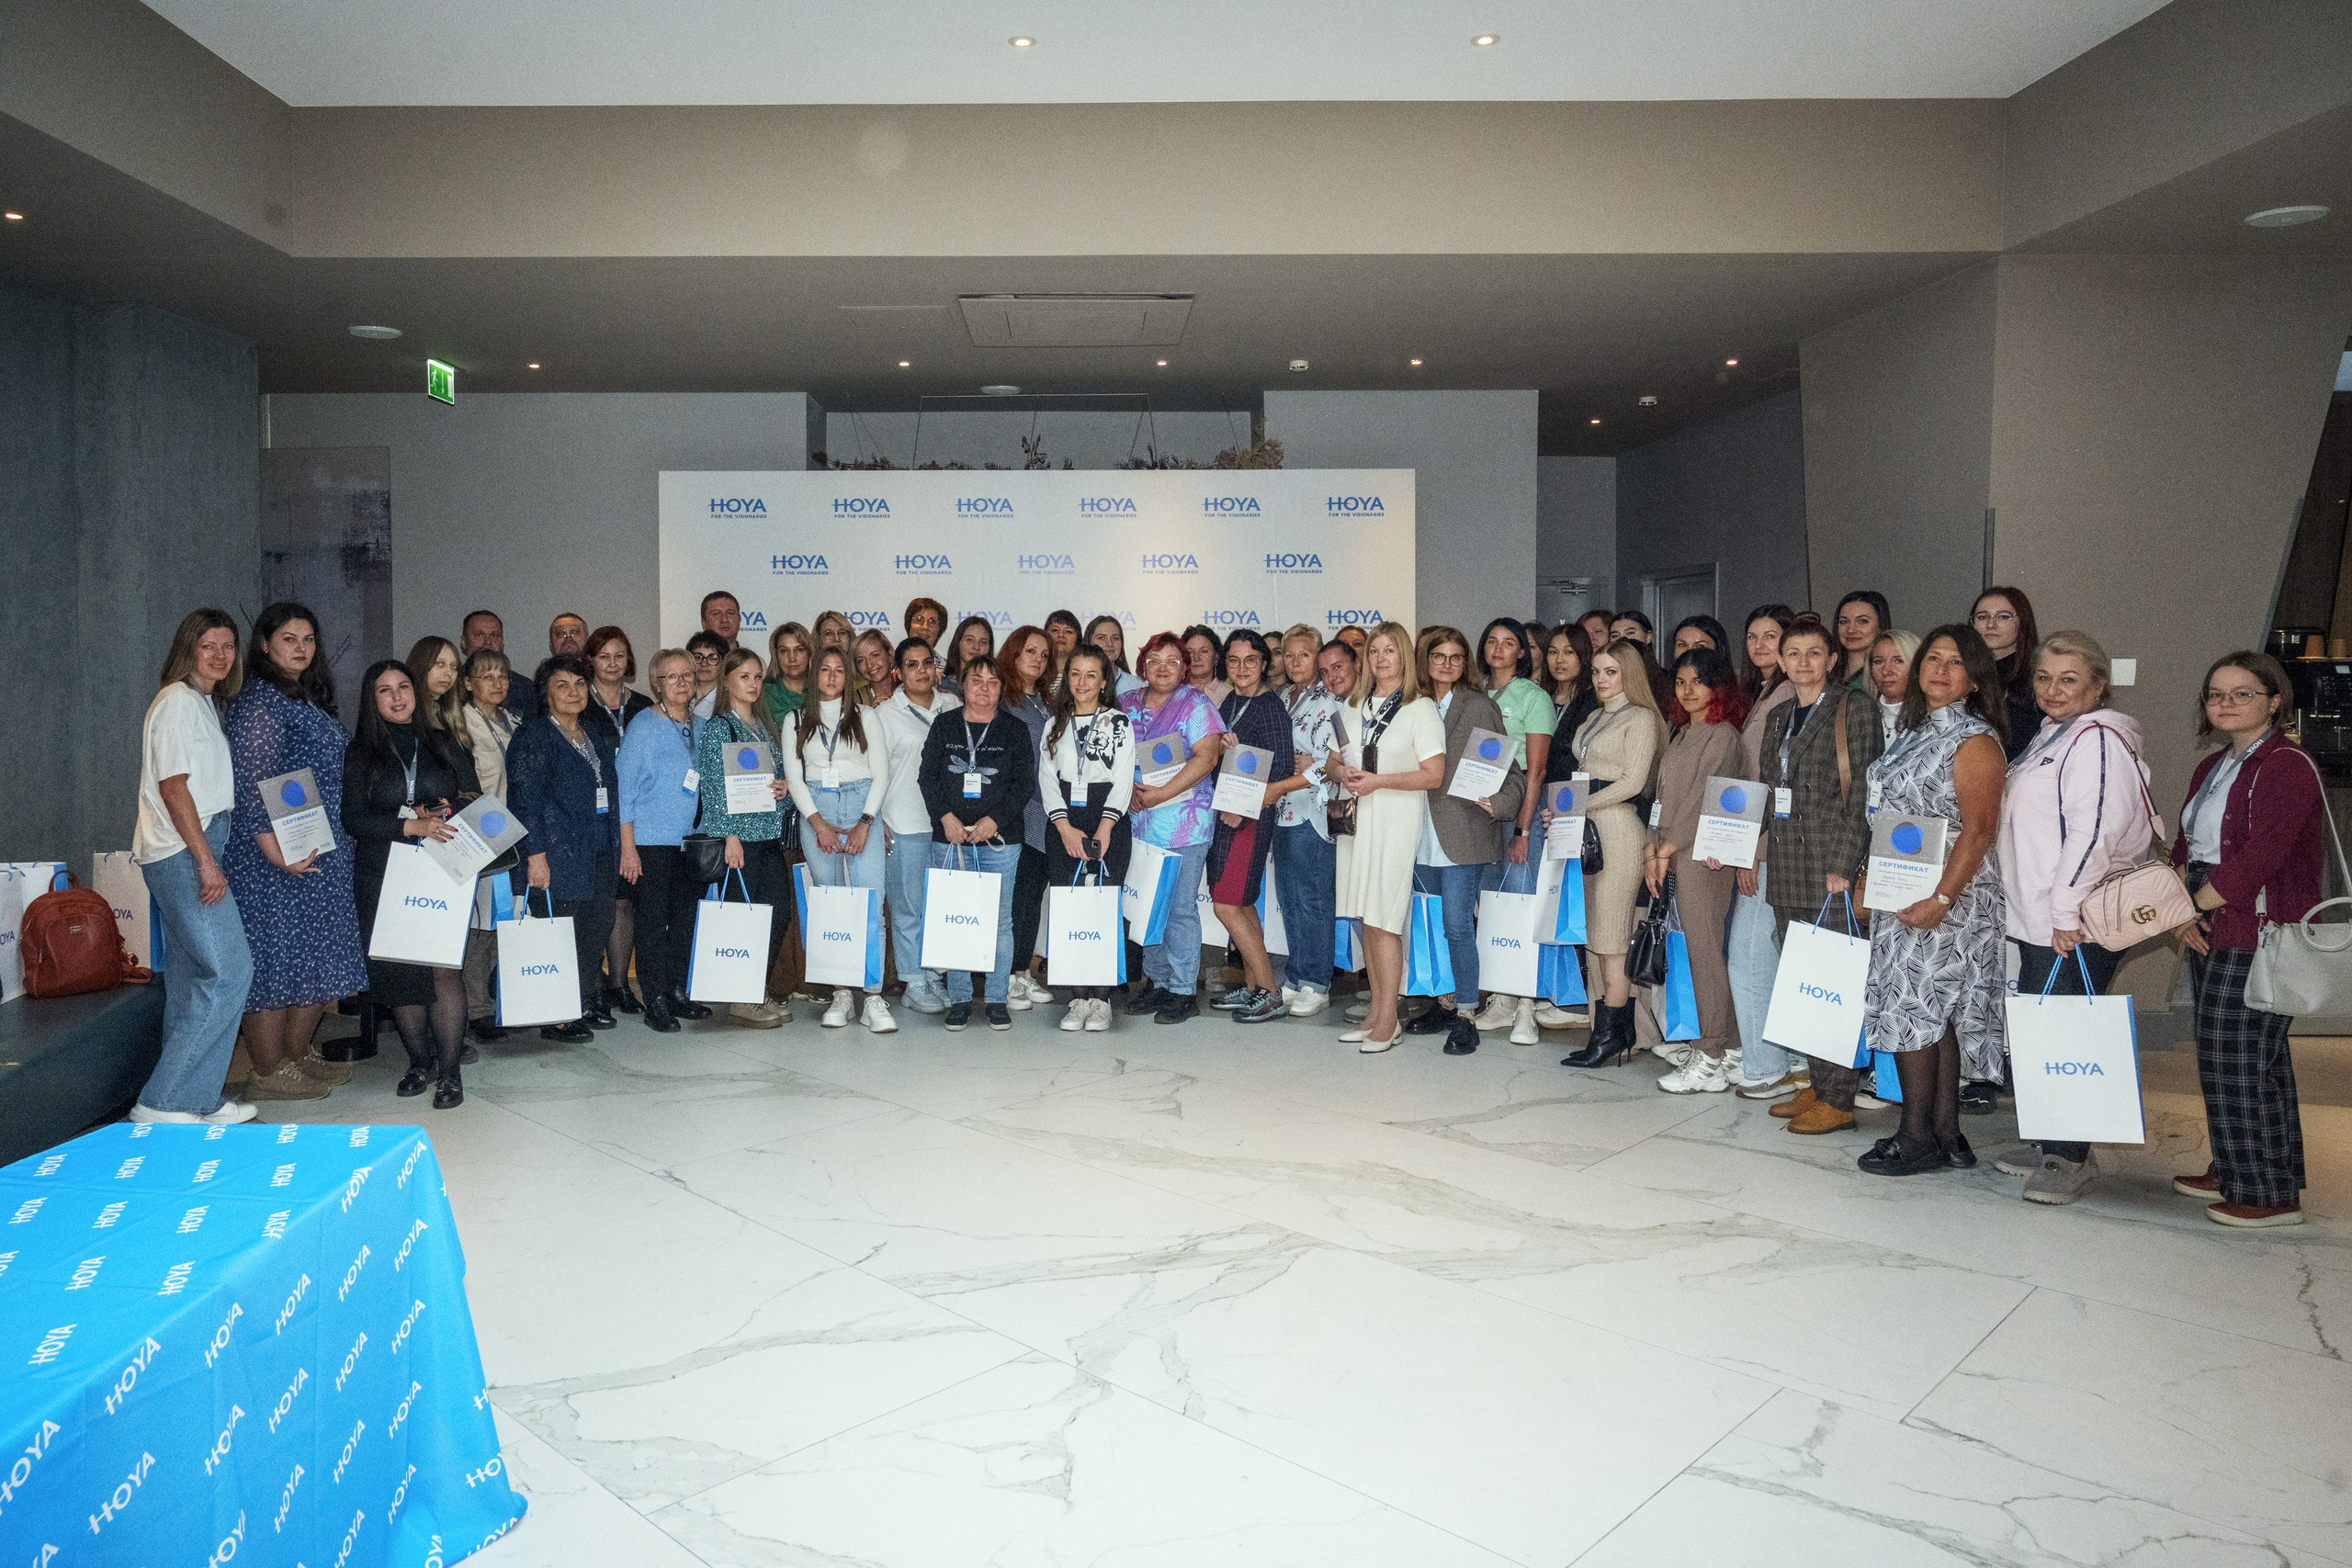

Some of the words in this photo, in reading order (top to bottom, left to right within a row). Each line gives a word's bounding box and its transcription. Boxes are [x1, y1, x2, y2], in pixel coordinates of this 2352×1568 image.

[709, 499, 767, 512] HOYA
[833, 498, 891, 512] HOYA
[956, 498, 1014, 512] HOYA
[1080, 498, 1138, 512] HOYA
[1203, 497, 1261, 511] HOYA
[1327, 497, 1385, 511] HOYA
[771, 555, 829, 569] HOYA
[894, 555, 952, 569] HOYA
[1018, 555, 1076, 568] HOYA
[1141, 554, 1199, 568] HOYA
[1265, 554, 1323, 568] HOYA
[739, 611, 767, 625] YA
[1203, 610, 1261, 624] HOYA
[1327, 610, 1383, 624] HOYA
[1816, 692, 1826, 705] HOYA
[2246, 739, 2264, 754] HOYA
[1465, 762, 1498, 774] СЕРТИФИКАТ
[1884, 754, 1897, 767] HOYA
[1150, 768, 1181, 779] СЕРТИФИКАТ
[1225, 777, 1259, 788] СЕРТИФИКАТ
[282, 811, 318, 826] СЕРТИФИКАТ
[1708, 819, 1750, 829] СЕРТИФИКАТ
[458, 823, 488, 854] СЕРТИФИКАТ
[1878, 861, 1929, 873] СЕРТИФИКАТ
[1123, 884, 1138, 899] OYA
[404, 896, 448, 911] HOYA
[114, 908, 133, 920] OYA
[945, 914, 979, 925] HOYA
[0, 931, 15, 945] OYA
[823, 931, 851, 942] HOYA
[1069, 931, 1101, 940] HOYA
[1491, 937, 1521, 949] HOYA
[715, 948, 750, 959] HOYA
[521, 964, 559, 976] HOYA
[1797, 982, 1842, 1005] HOYA
[2044, 1062, 2105, 1076] HOYA
[349, 1126, 370, 1148] HOYA
[33, 1154, 68, 1177] HOYA
[114, 1156, 146, 1179] HOYA
[192, 1159, 221, 1183] HOYA
[396, 1140, 427, 1190] HOYA
[270, 1163, 296, 1187] HOYA
[341, 1167, 372, 1213] HOYA
[8, 1197, 47, 1224] HOYA
[92, 1201, 129, 1229] HOYA
[176, 1205, 210, 1234] HOYA
[261, 1209, 291, 1239] HOYA
[394, 1218, 428, 1272] HOYA
[65, 1256, 106, 1291] HOYA
[158, 1261, 195, 1296] HOYA
[338, 1245, 371, 1302] HOYA
[275, 1273, 311, 1336] HOYA
[391, 1299, 426, 1355] HOYA
[204, 1303, 244, 1369] HOYA
[28, 1324, 77, 1365] HOYA
[335, 1332, 368, 1392] HOYA
[103, 1337, 161, 1416] HOYA
[268, 1368, 309, 1434] HOYA
[389, 1381, 422, 1439] HOYA
[204, 1404, 246, 1476] HOYA
[333, 1420, 366, 1484] HOYA
[87, 1451, 156, 1535] HOYA
[274, 1464, 305, 1534] HOYA
[388, 1464, 417, 1525] HOYA
